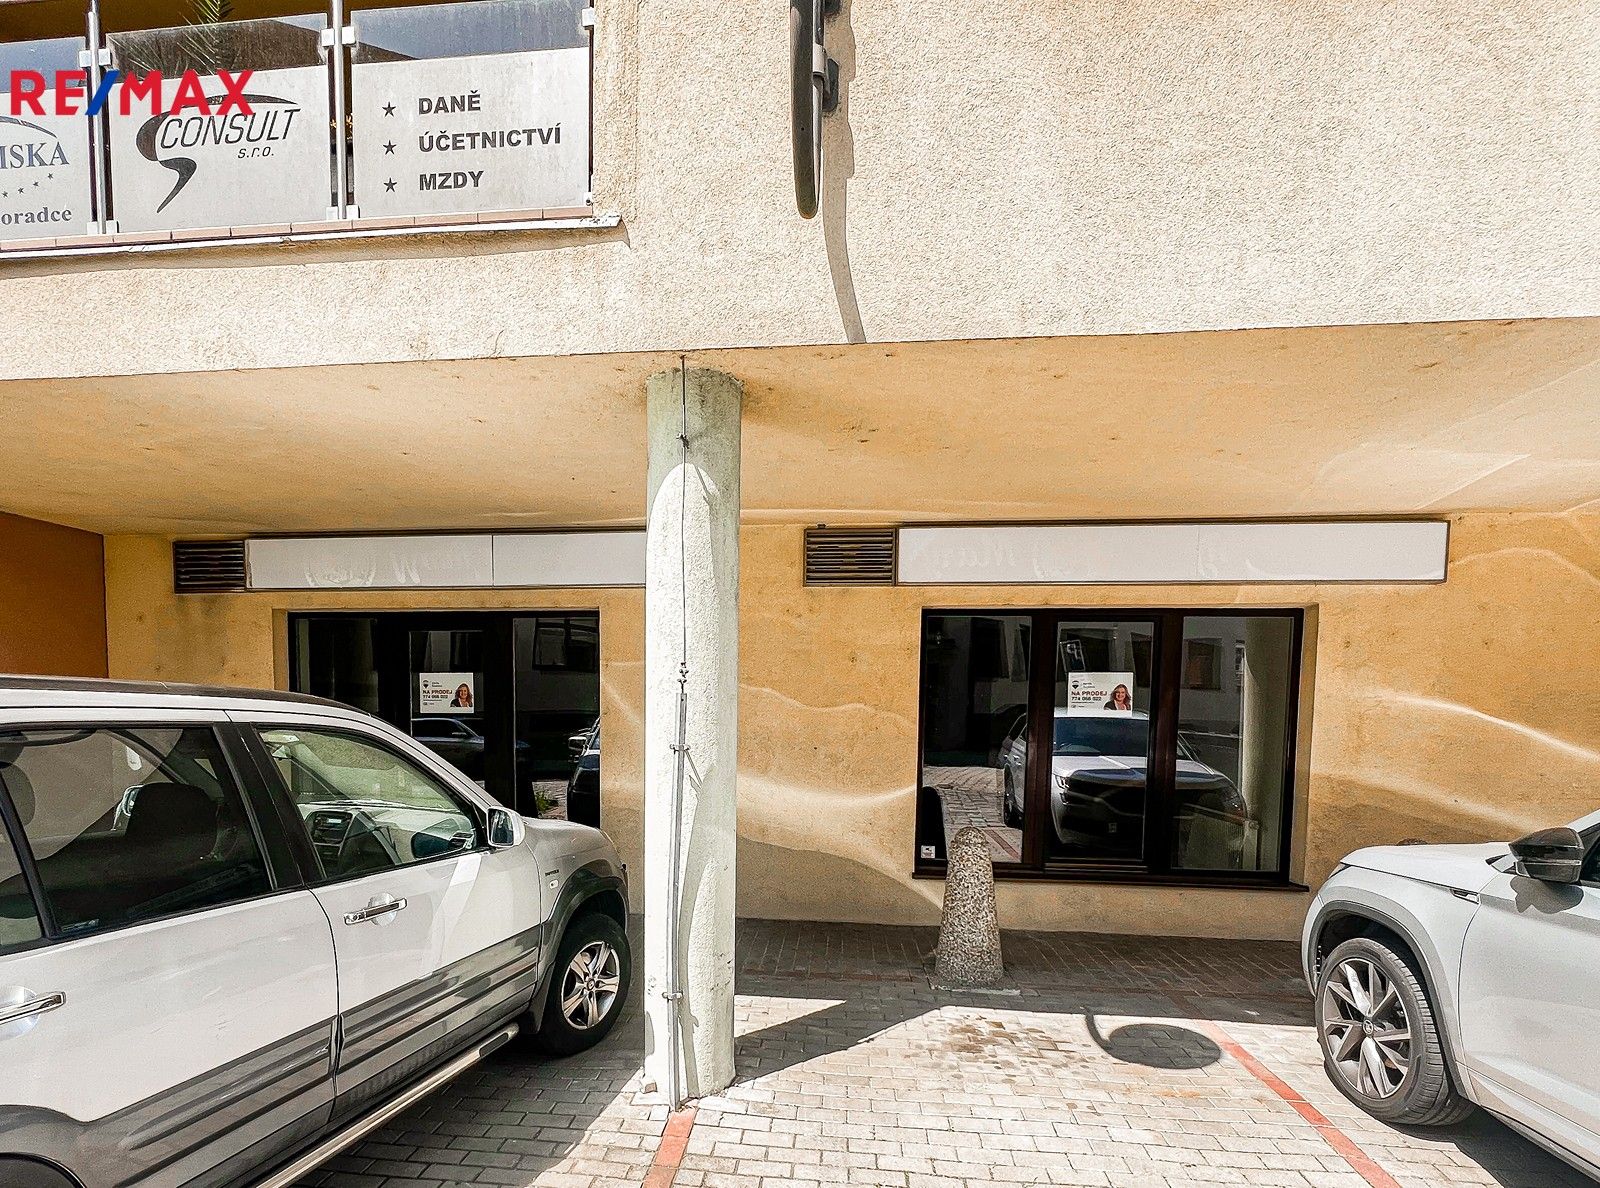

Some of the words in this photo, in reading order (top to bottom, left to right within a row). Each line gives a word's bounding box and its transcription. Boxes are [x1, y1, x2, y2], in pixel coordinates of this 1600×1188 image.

[418, 89, 481, 116] DANĚ
[160, 108, 301, 149] CONSULT
[418, 122, 562, 153] ÚČETNICTVÍ
[237, 146, 275, 159] s.r.o.
[419, 170, 485, 191] MZDY
[0, 206, 72, 226] oradce
